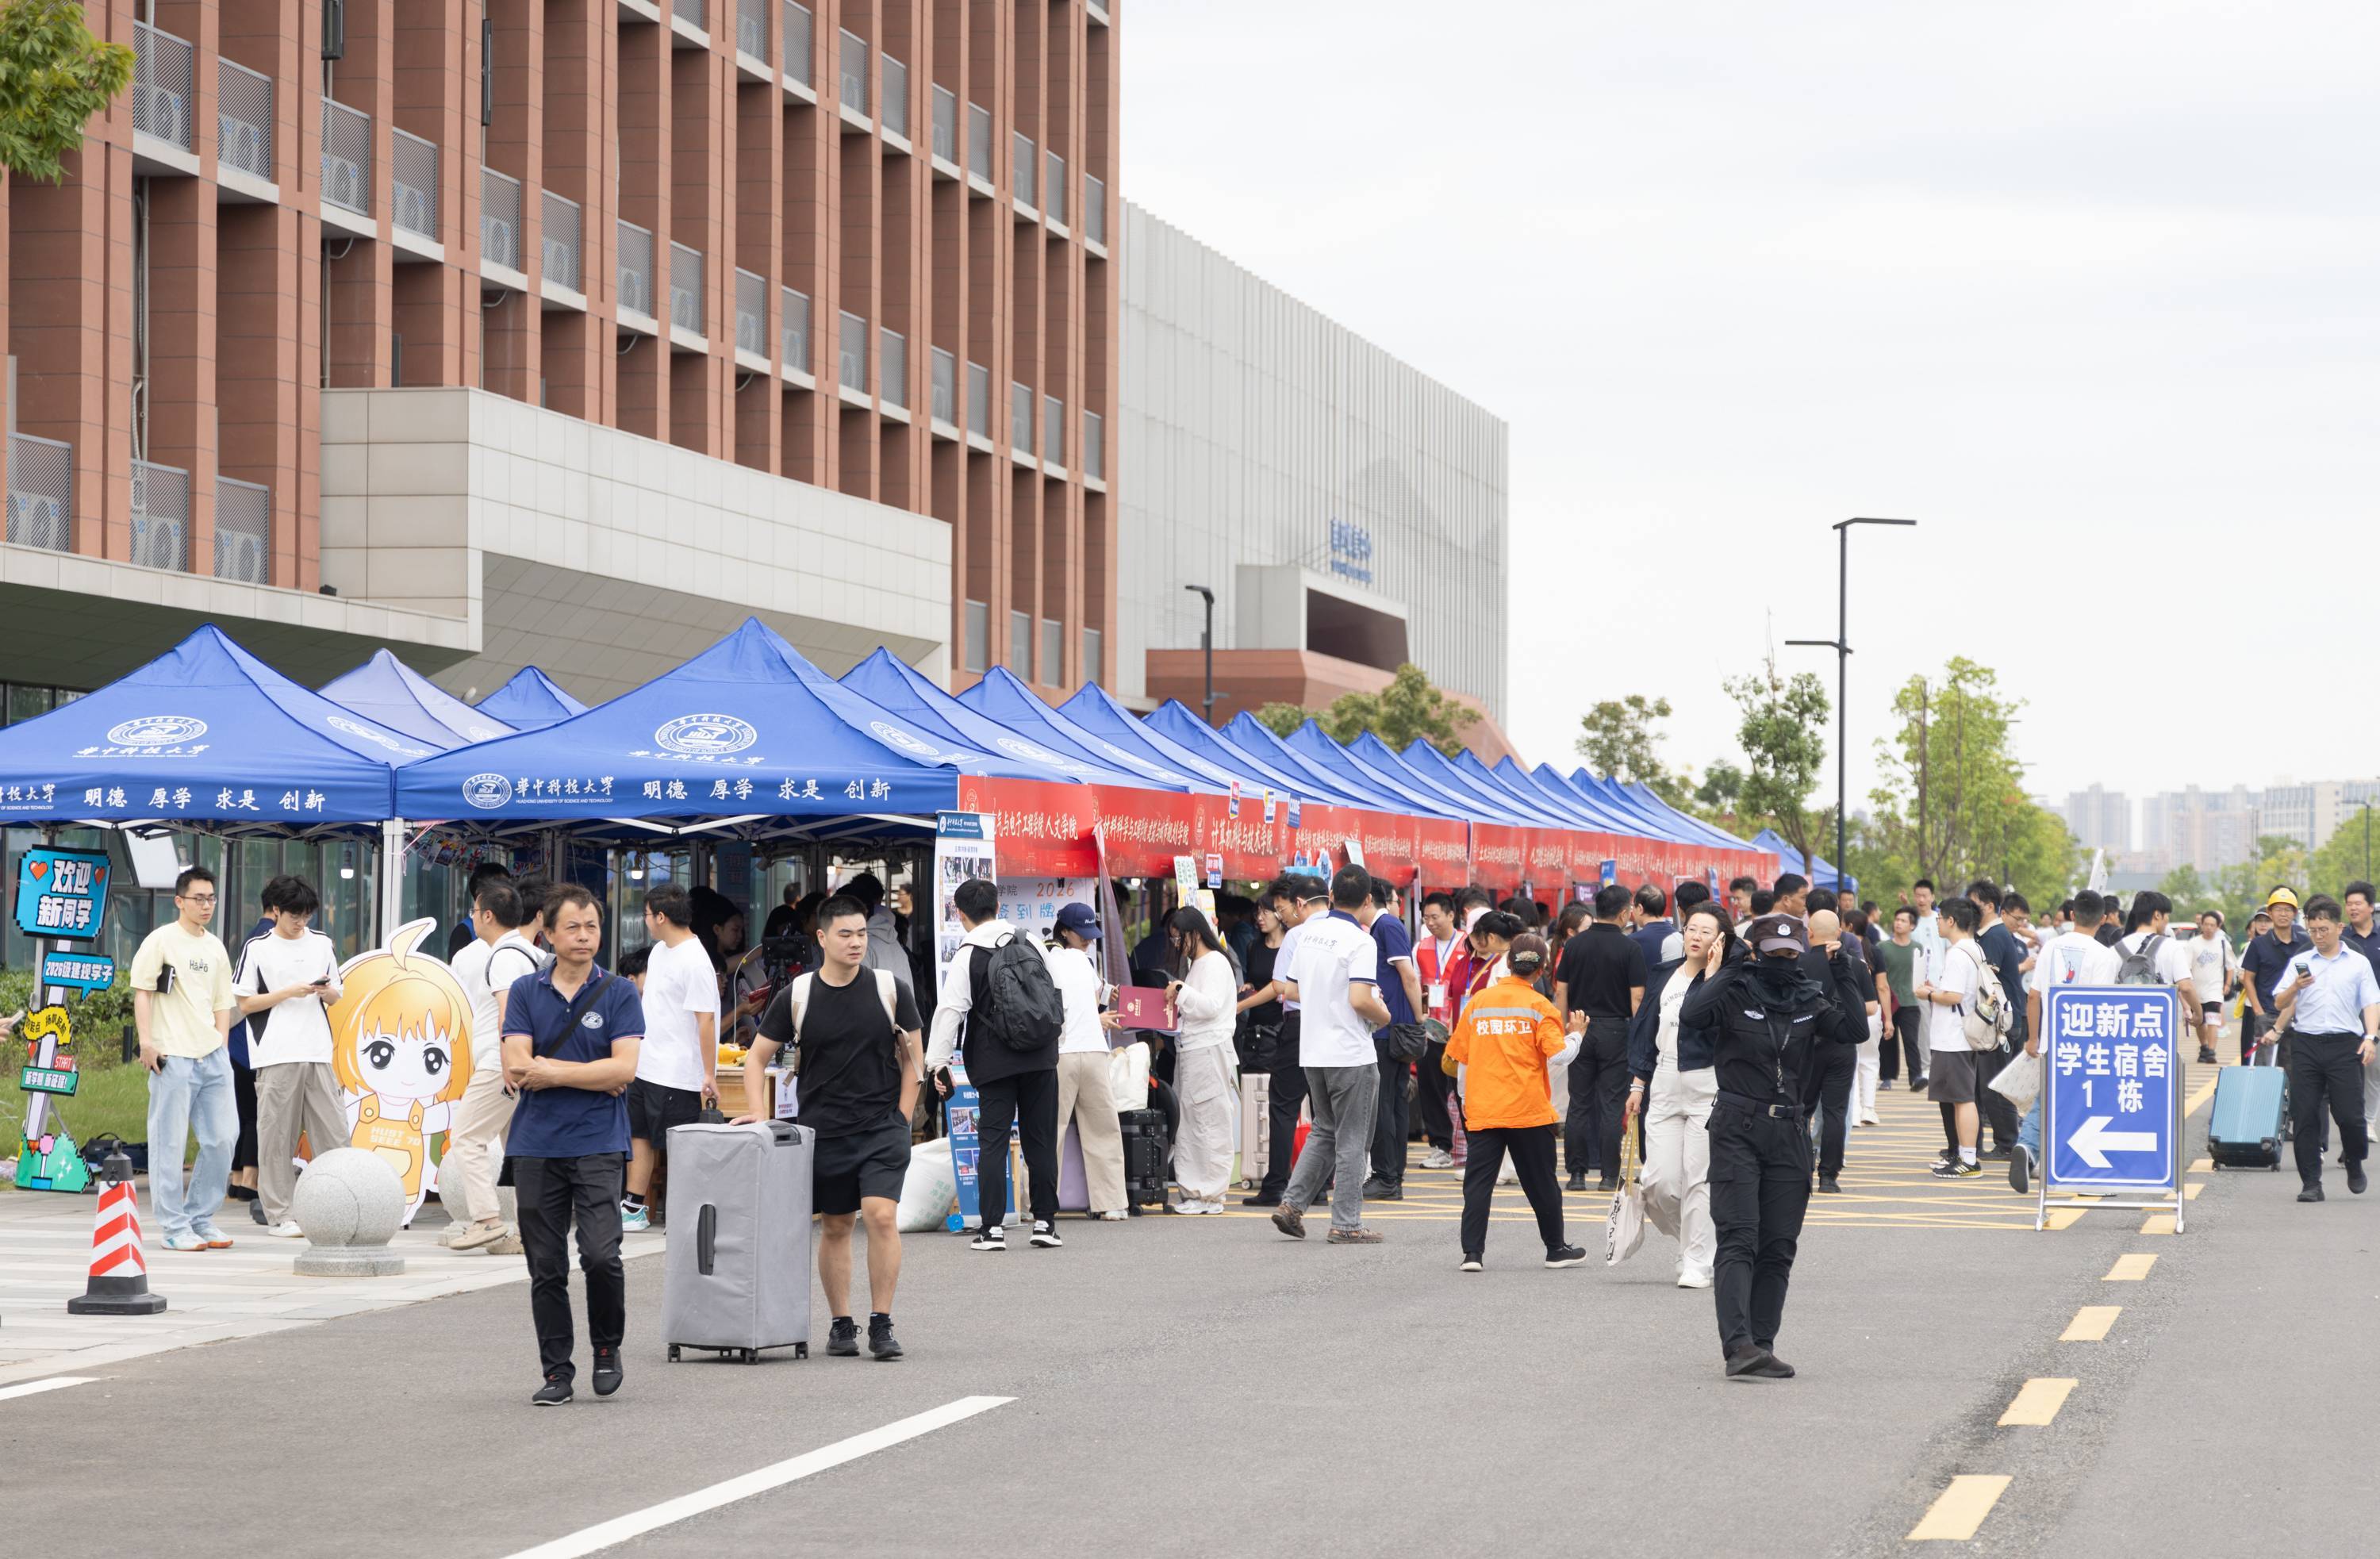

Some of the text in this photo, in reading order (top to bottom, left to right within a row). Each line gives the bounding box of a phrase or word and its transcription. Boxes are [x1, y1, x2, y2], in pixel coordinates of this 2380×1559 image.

[83, 786, 326, 812] 明德 厚学 求是 创新
[642, 777, 891, 801] 明德 厚学 求是 创新
[51, 859, 93, 895] 欢迎
[997, 883, 1075, 898] 学院 2026
[36, 895, 94, 929] 新同学
[997, 903, 1055, 920] 签到牌
[1476, 1019, 1533, 1036] 校园环卫
[2061, 1003, 2164, 1039] 迎新点
[55, 1056, 72, 1069] START
[2056, 1043, 2167, 1078] 学生宿舍
[2082, 1079, 2144, 1113] 1 栋
